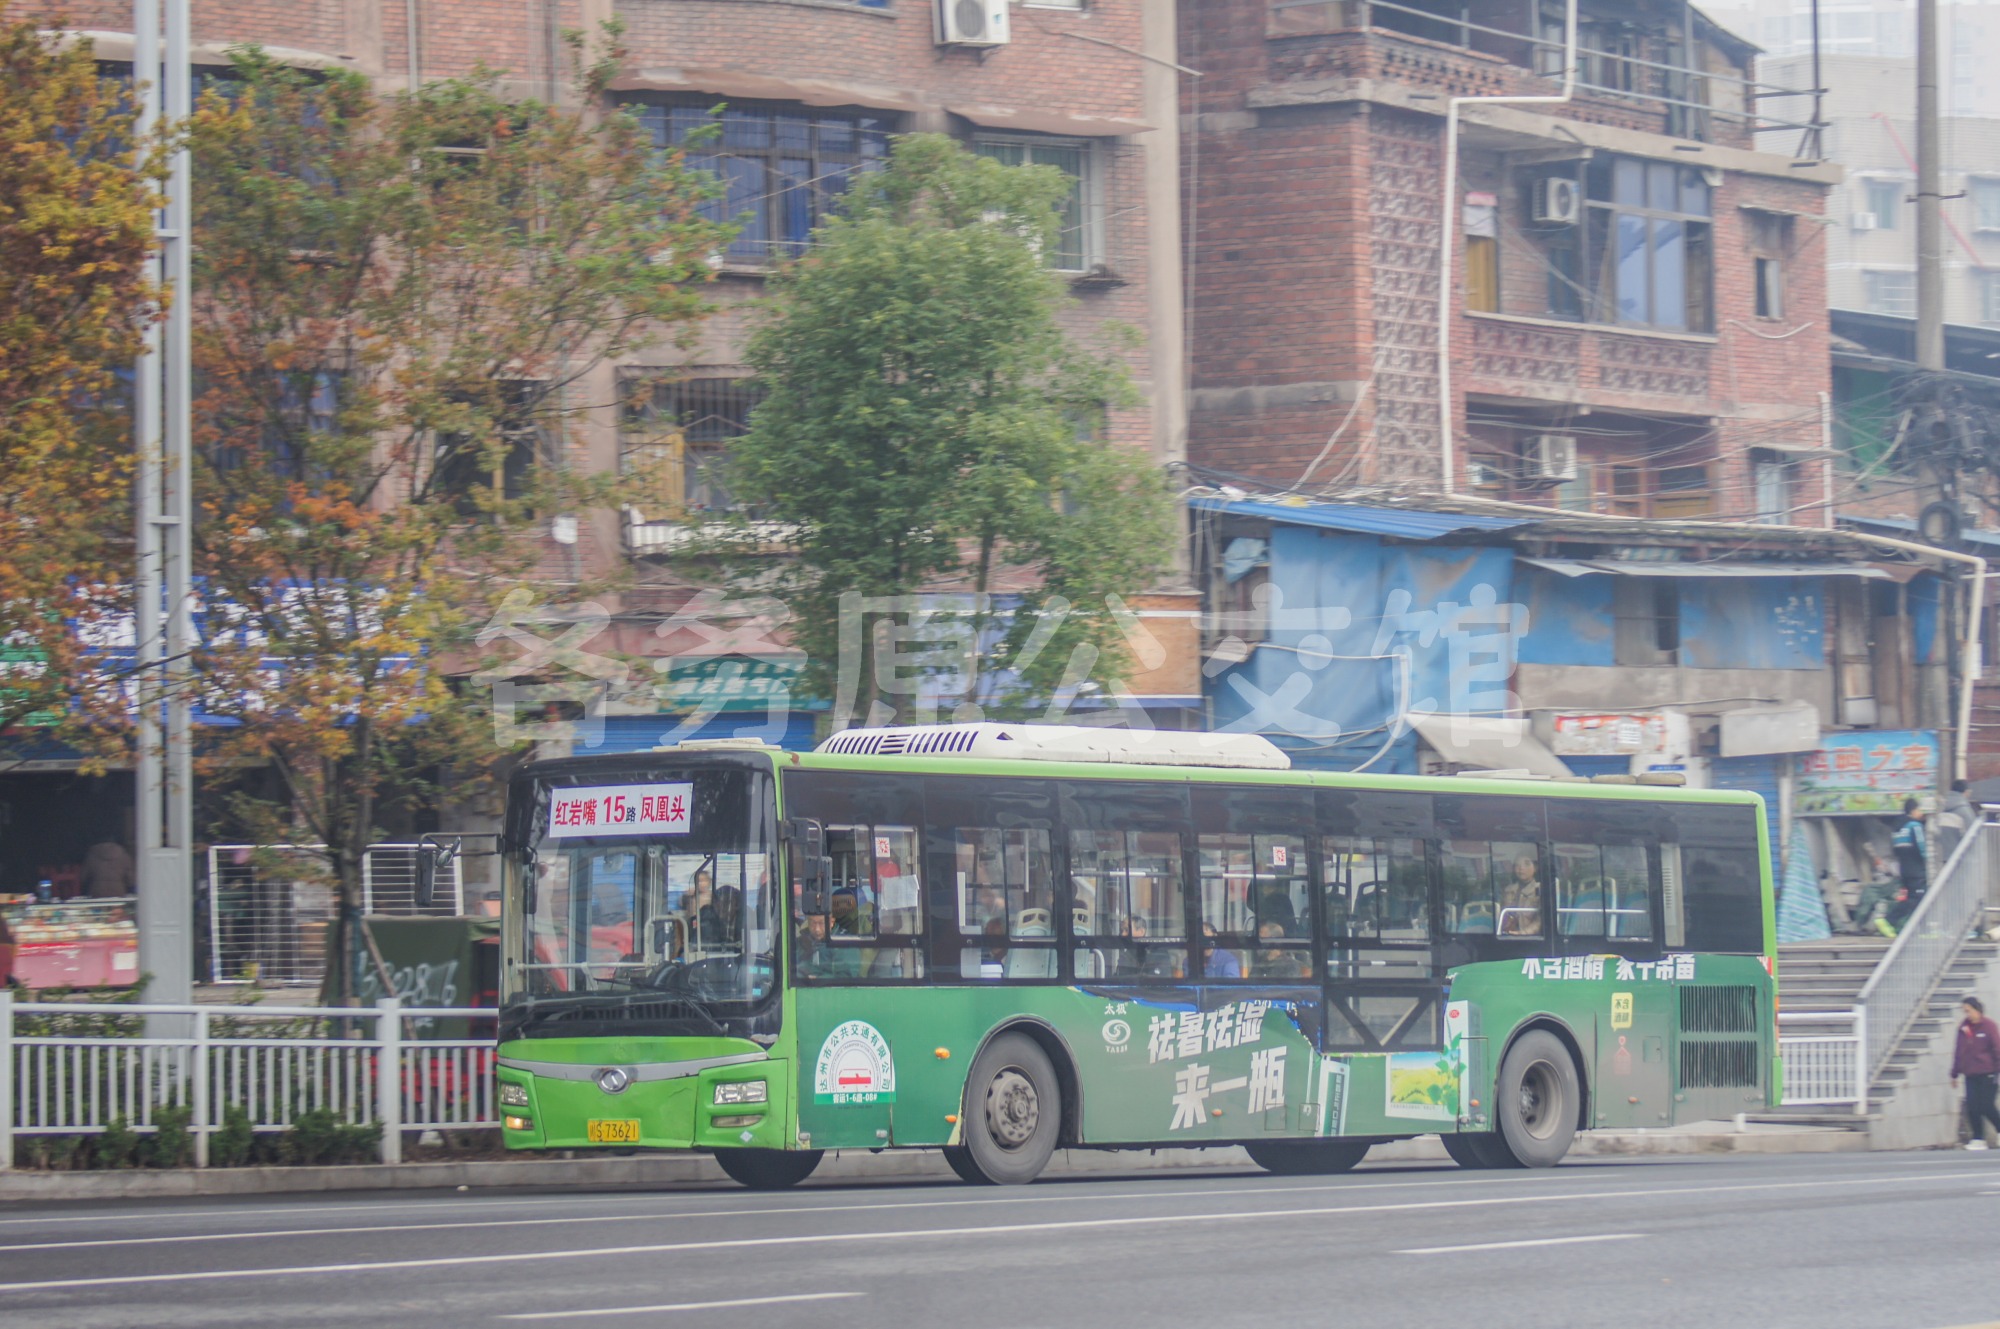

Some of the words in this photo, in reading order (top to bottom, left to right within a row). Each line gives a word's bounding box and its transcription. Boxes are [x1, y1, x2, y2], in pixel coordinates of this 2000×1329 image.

[555, 799, 597, 826] 红岩嘴
[640, 795, 685, 822] 凤凰头
[1104, 1003, 1127, 1016] 太极
[1148, 1002, 1267, 1064] 祛暑祛湿
[820, 1024, 891, 1092] 达州市公共交通有限公司
[1169, 1046, 1287, 1130] 来一瓶
